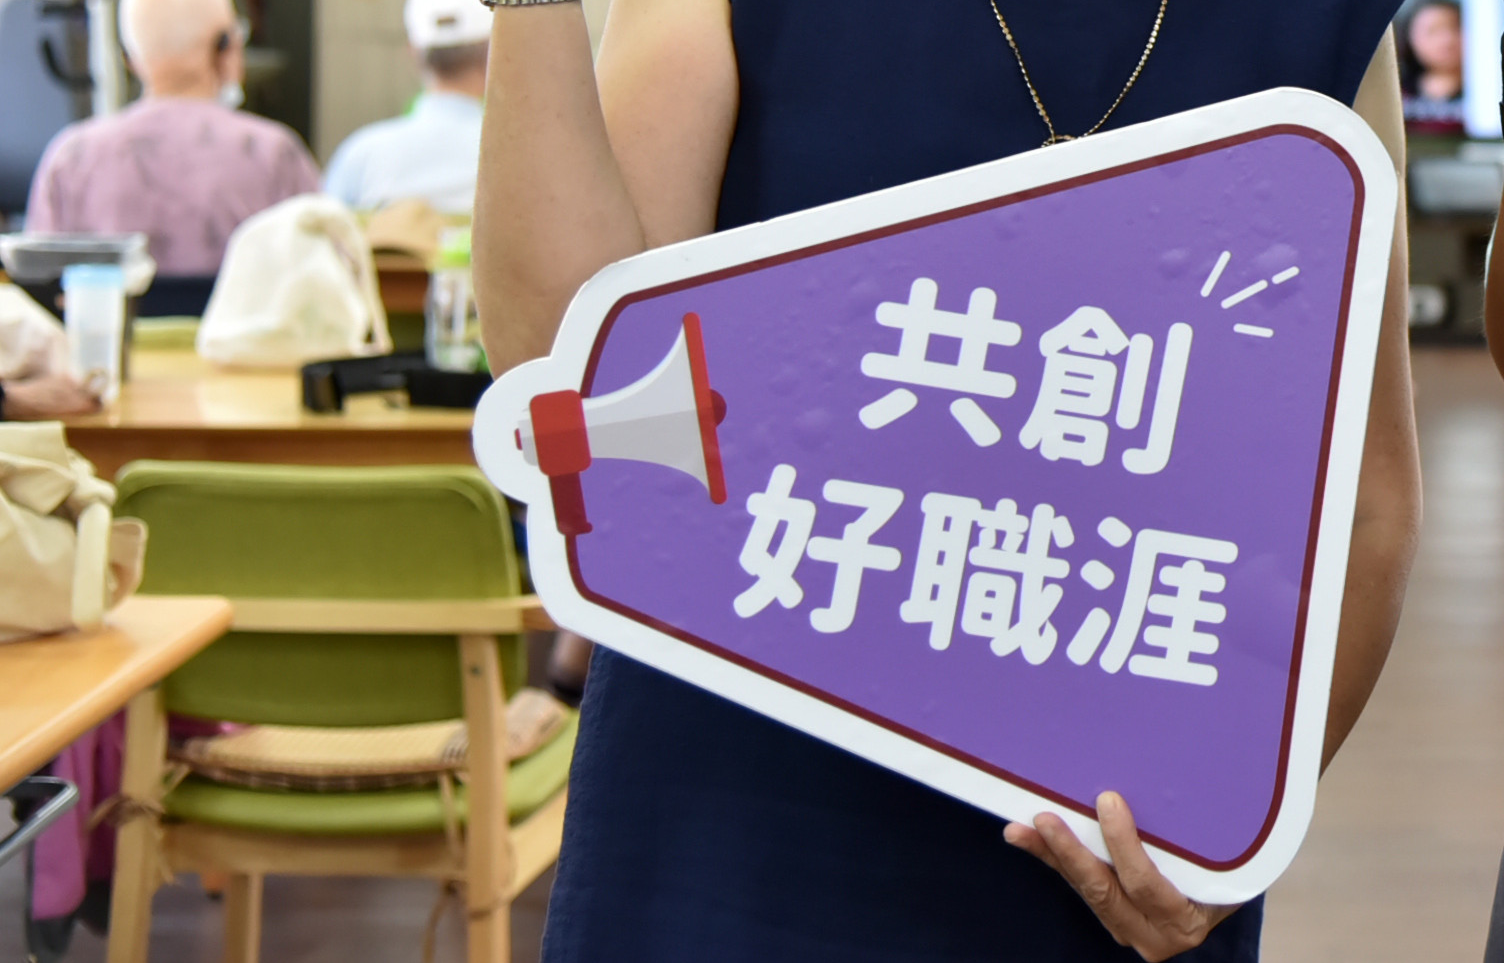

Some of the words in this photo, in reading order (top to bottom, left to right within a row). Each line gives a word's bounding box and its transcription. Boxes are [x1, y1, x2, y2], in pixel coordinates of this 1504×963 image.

[858, 277, 1194, 474] 共創
[733, 464, 1239, 686] 好職涯
